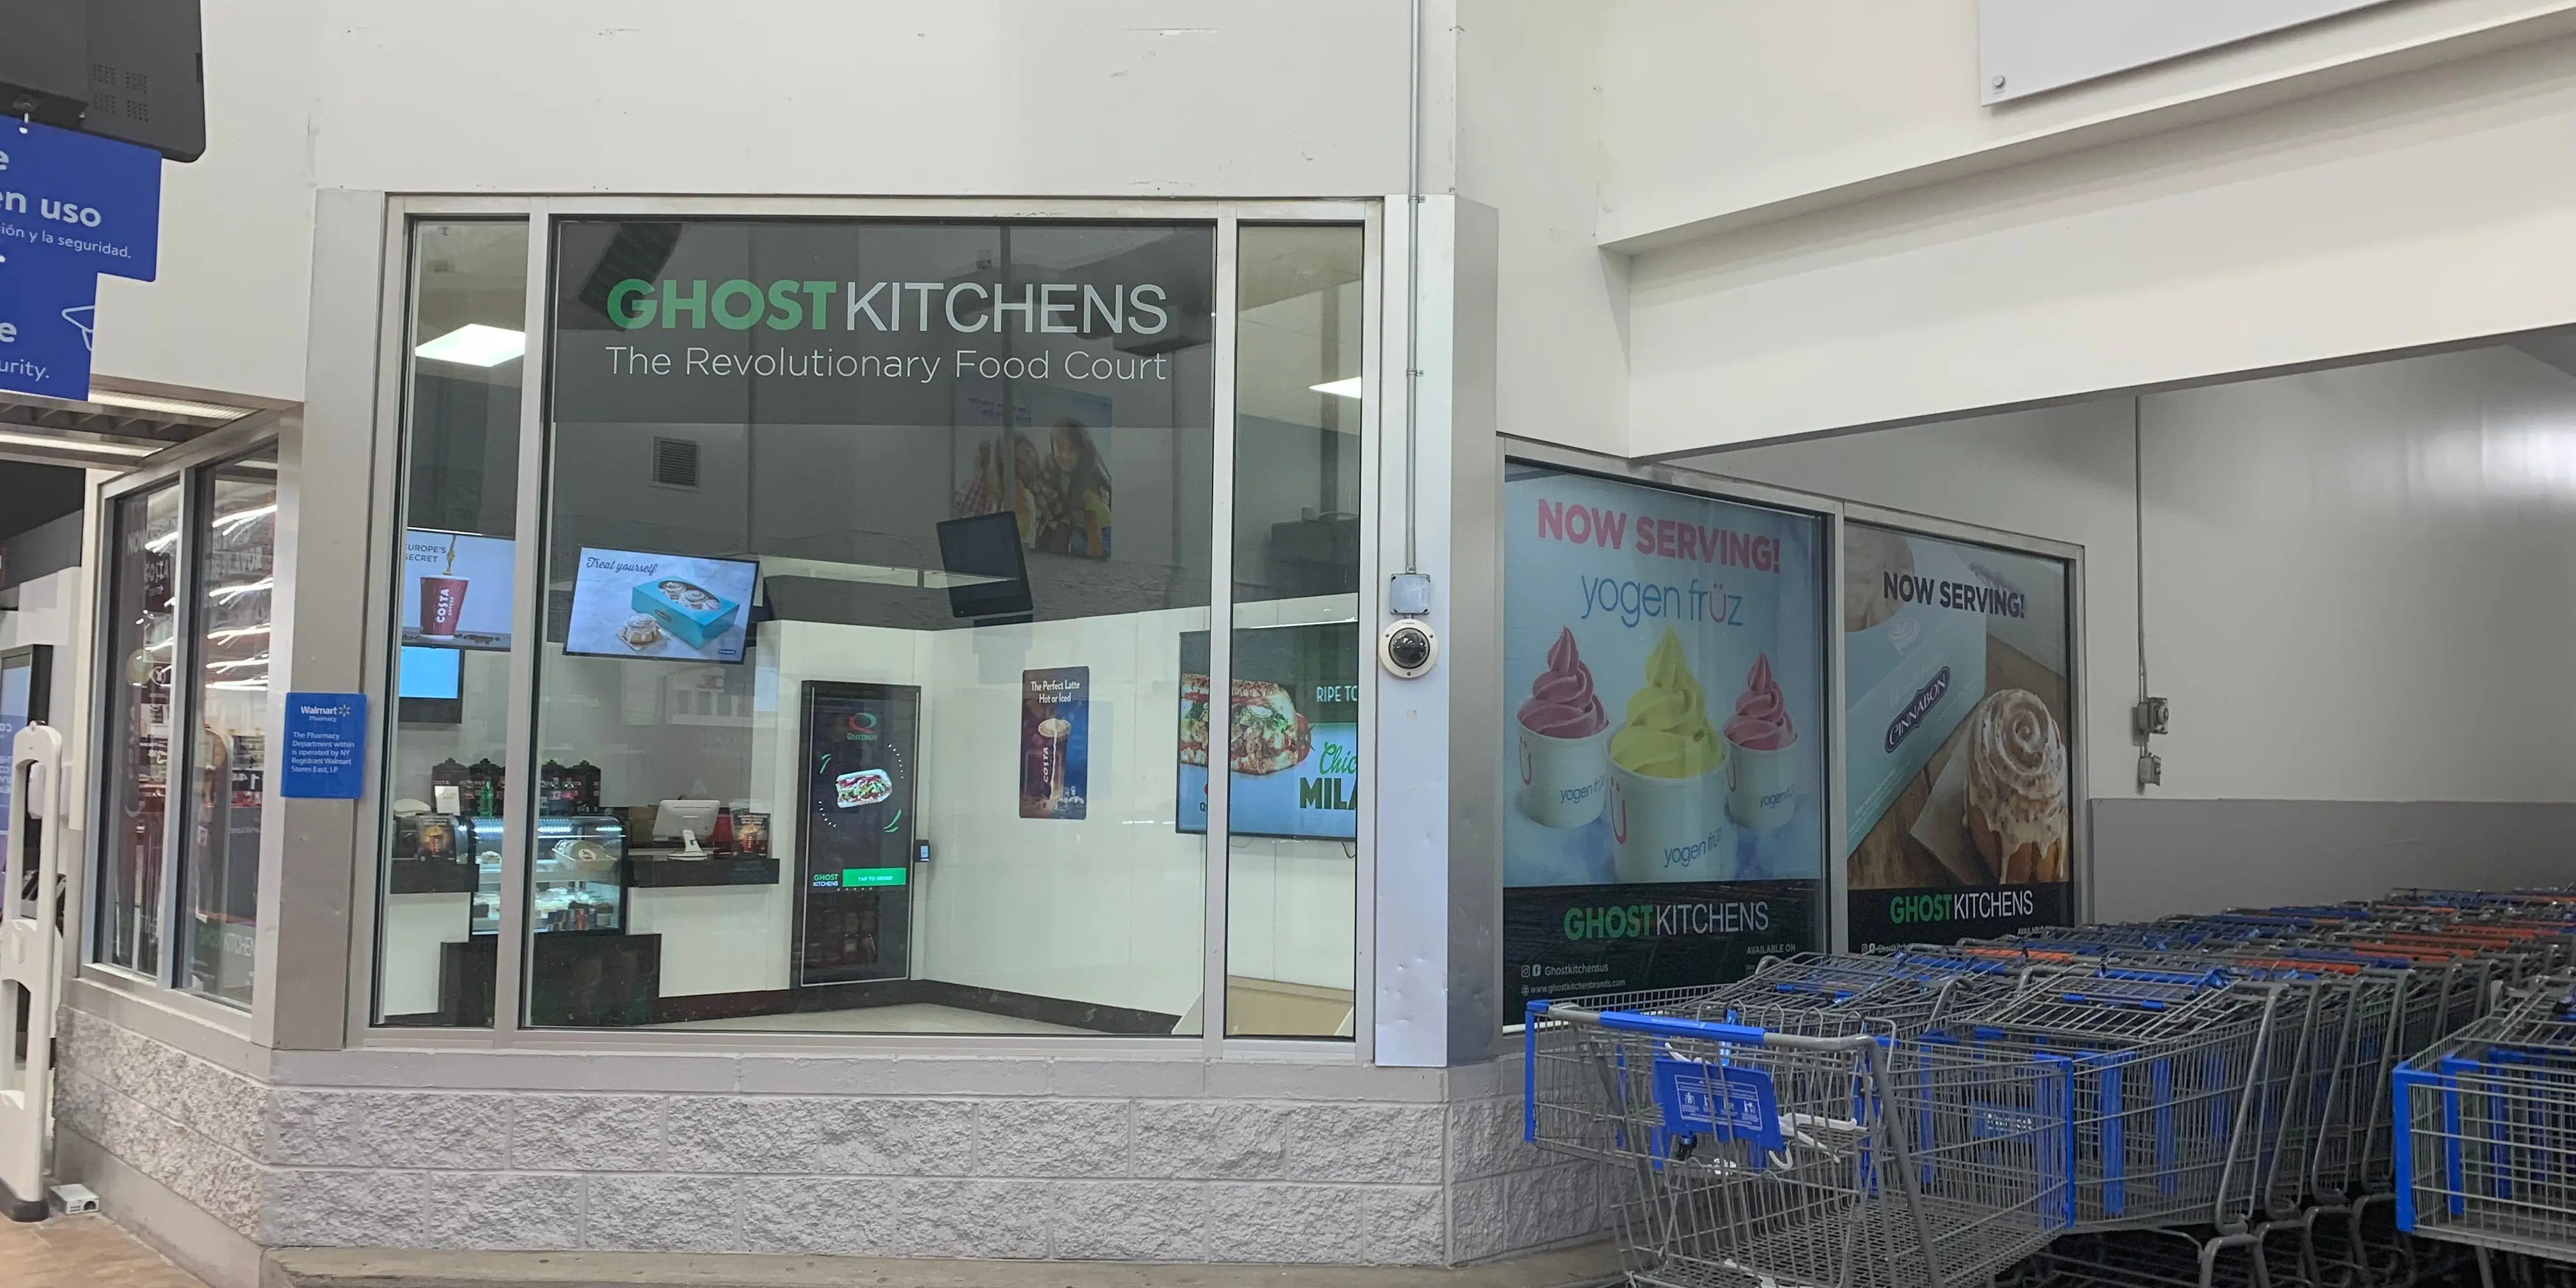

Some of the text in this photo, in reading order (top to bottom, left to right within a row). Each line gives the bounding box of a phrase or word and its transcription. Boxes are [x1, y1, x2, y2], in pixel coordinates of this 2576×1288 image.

[0, 191, 101, 227] n uso
[0, 223, 132, 259] ión y la seguridad.
[607, 279, 1168, 335] GHOST KITCHENS
[605, 346, 1167, 383] The Revolutionary Food Court
[406, 544, 447, 554] UROPE'S
[1538, 498, 1781, 573] NOW SERVING!
[586, 556, 658, 576] Treat yourself
[436, 588, 450, 623] COSTA
[1581, 575, 1744, 628] yogen früz
[1884, 571, 2025, 618] NOW SERVING!
[1031, 679, 1080, 691] The Perfect Latte
[1039, 694, 1051, 703] Hot
[1059, 693, 1071, 703] Iced
[1316, 686, 1341, 702] RIPE
[300, 705, 337, 715] Walmart
[1889, 673, 1946, 745] CINNABON
[1560, 785, 1592, 804] yogen
[1664, 840, 1706, 868] yogen
[1564, 901, 1768, 940] GHOST KITCHENS
[1890, 890, 2034, 924] GHOST KITCHENS
[1747, 943, 1796, 954] AVAILABLE ON
[1545, 963, 1609, 976] Ghostkitchensus
[1530, 979, 1626, 994] www.ghostkitchenbrands.com
